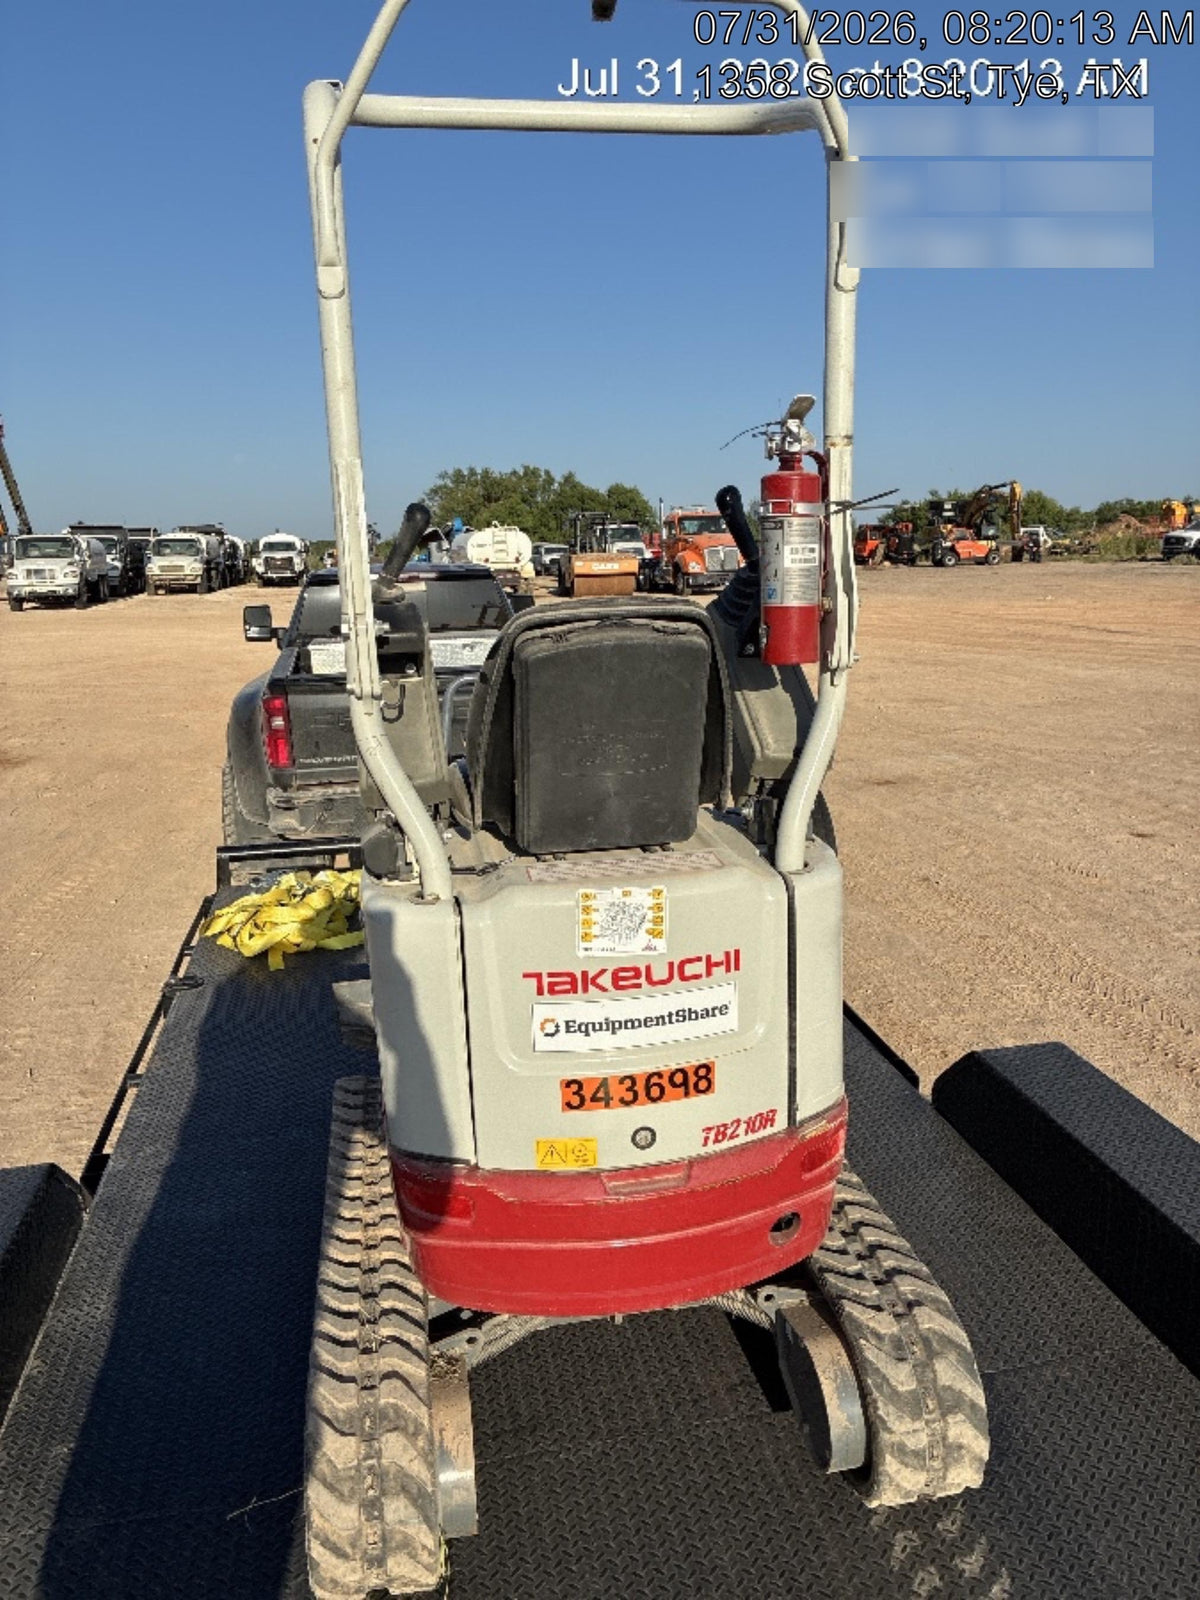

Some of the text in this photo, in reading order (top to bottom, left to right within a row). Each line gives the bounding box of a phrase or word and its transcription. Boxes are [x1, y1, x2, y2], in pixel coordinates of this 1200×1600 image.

[522, 948, 742, 997] TAKEUCHI
[564, 1002, 730, 1037] EquipmentShare
[564, 1062, 713, 1111] 343698
[702, 1108, 778, 1148] TB210R
